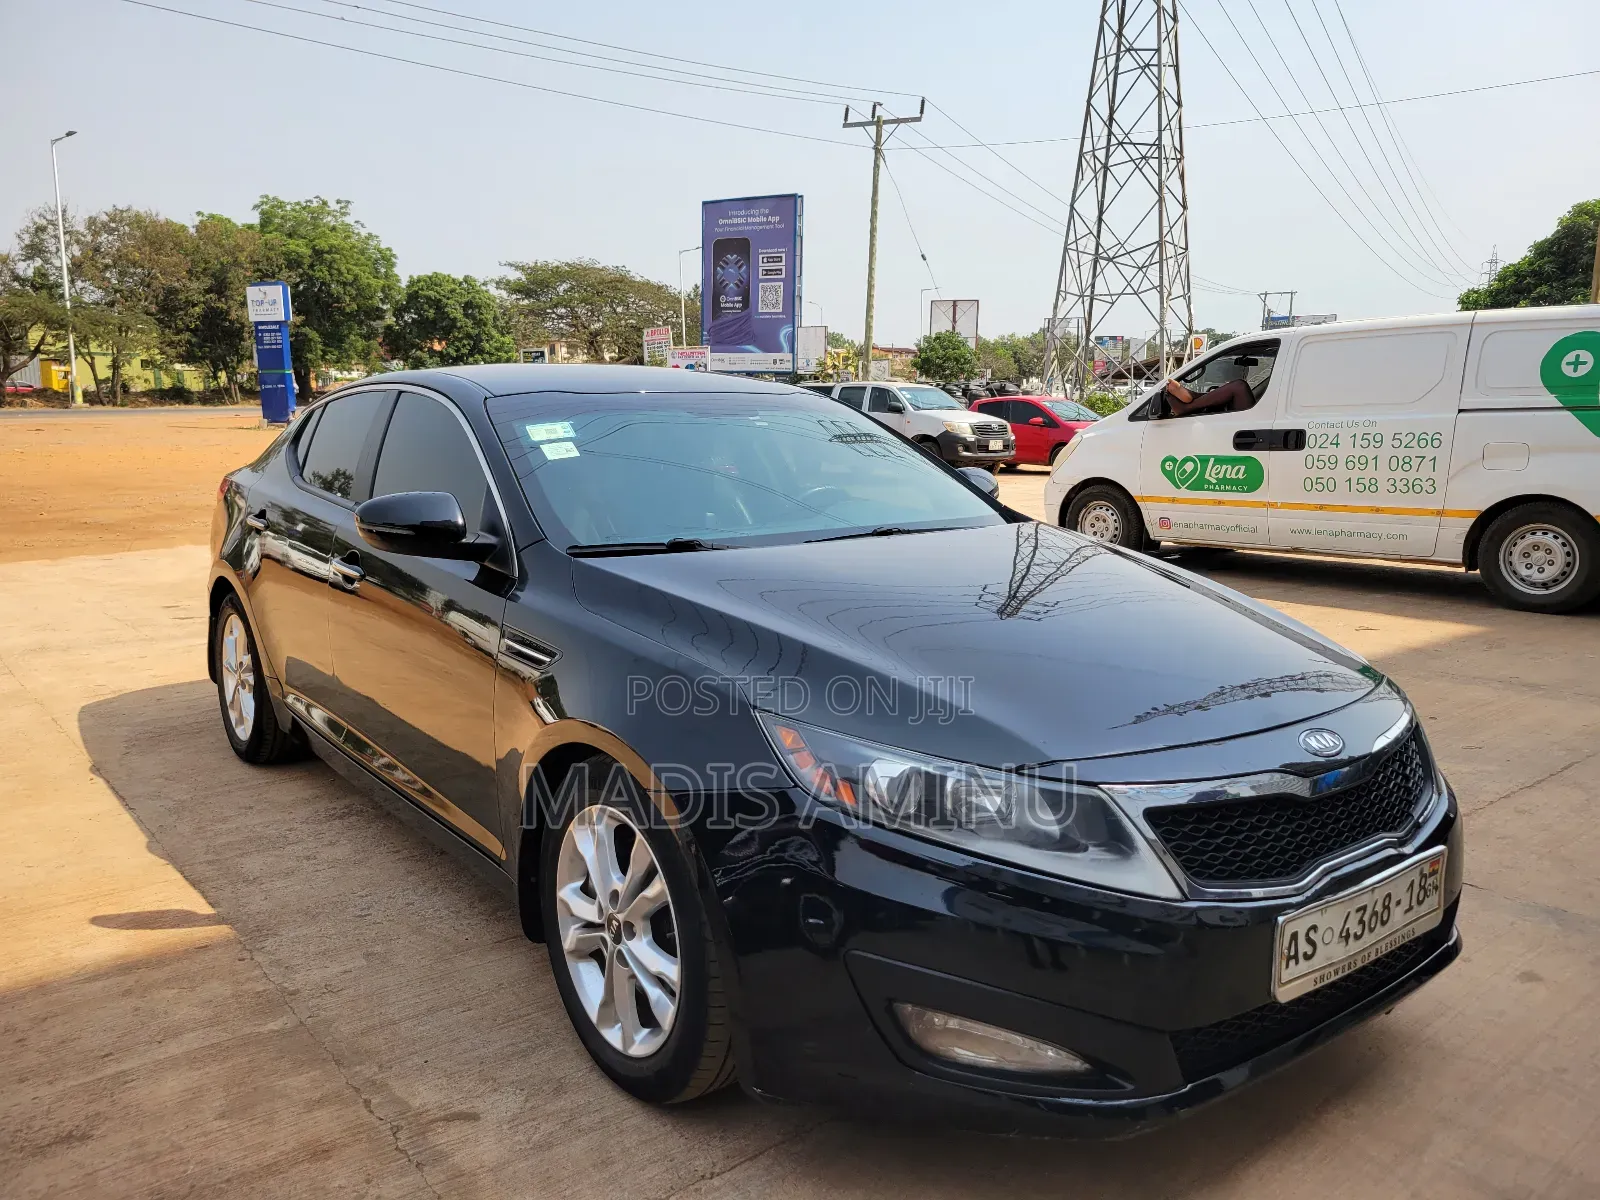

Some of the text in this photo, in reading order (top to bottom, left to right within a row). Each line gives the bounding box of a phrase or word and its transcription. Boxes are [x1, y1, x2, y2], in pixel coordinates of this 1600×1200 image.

[718, 215, 780, 225] OmniBSIC Mobile App
[728, 208, 759, 216] Introducing
[744, 223, 774, 231] Management
[1307, 419, 1377, 430] Contact Us On
[1307, 431, 1443, 449] 024 159 5266
[1204, 457, 1247, 484] Lena
[1304, 454, 1437, 472] 059 691 0871
[1204, 484, 1248, 492] PHARMACY
[1303, 476, 1437, 495] 050 158 3363
[1289, 527, 1408, 541] www.lenapharmacy.com
[1304, 732, 1339, 751] KIA
[1284, 872, 1428, 969] AS 4368-18
[1313, 927, 1416, 987] SHOWERS OF BLESSINGS
